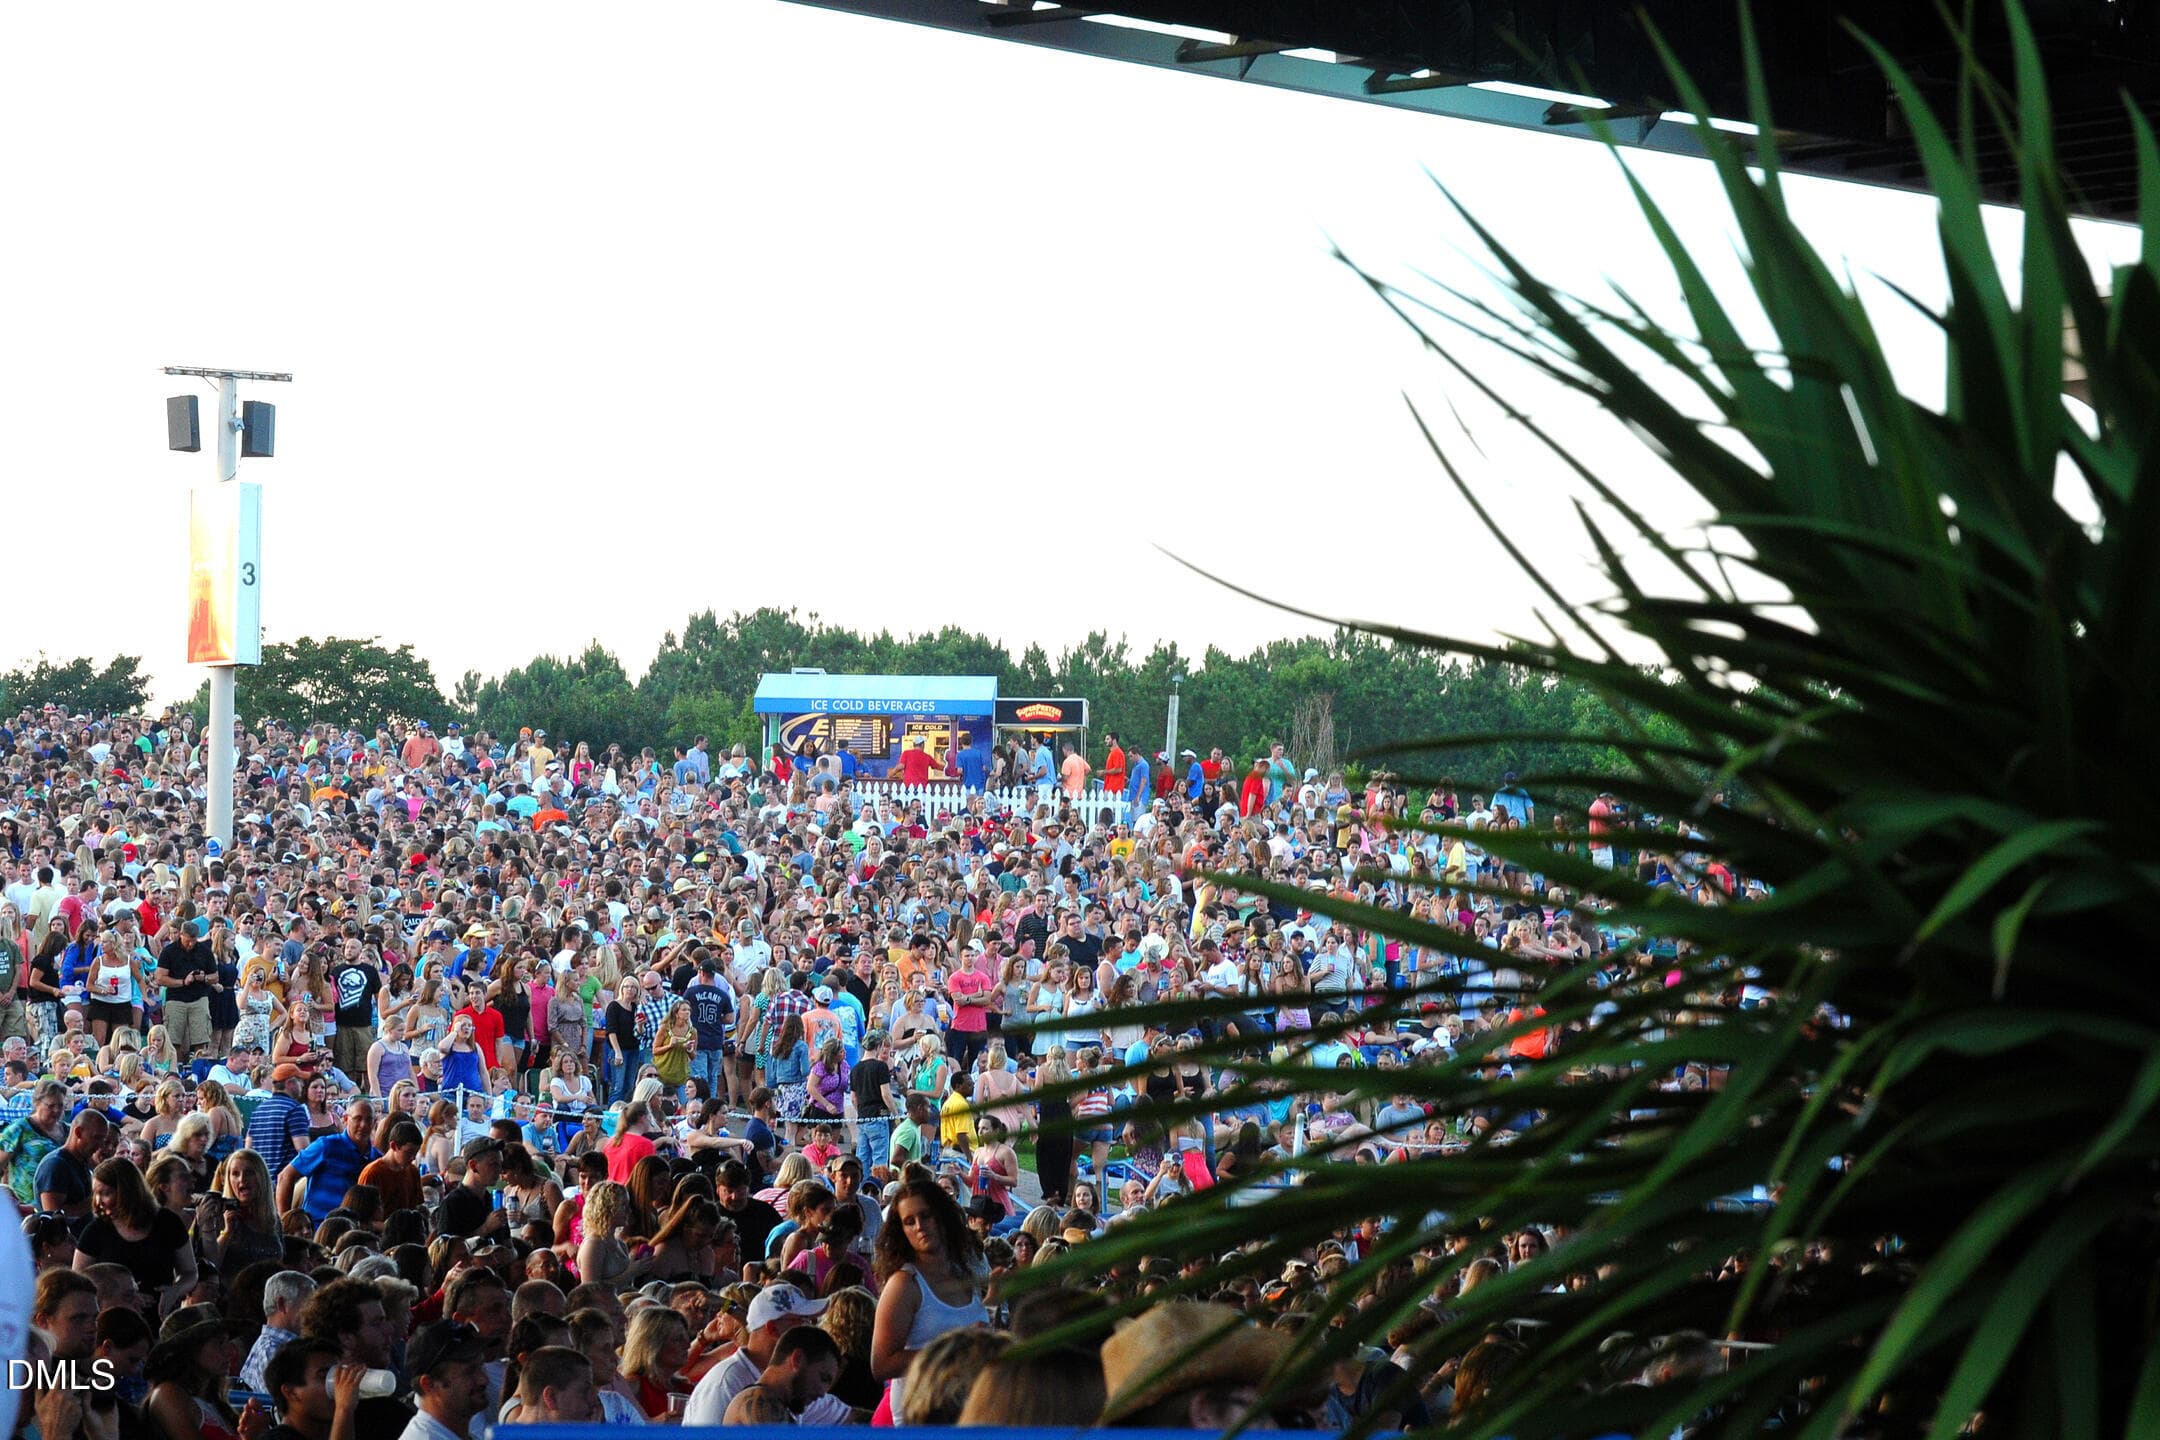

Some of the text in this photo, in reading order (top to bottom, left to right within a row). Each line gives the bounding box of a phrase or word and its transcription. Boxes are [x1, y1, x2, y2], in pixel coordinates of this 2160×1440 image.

[242, 562, 256, 586] 3
[811, 700, 936, 712] ICE COLD BEVERAGES
[698, 1002, 718, 1024] 16
